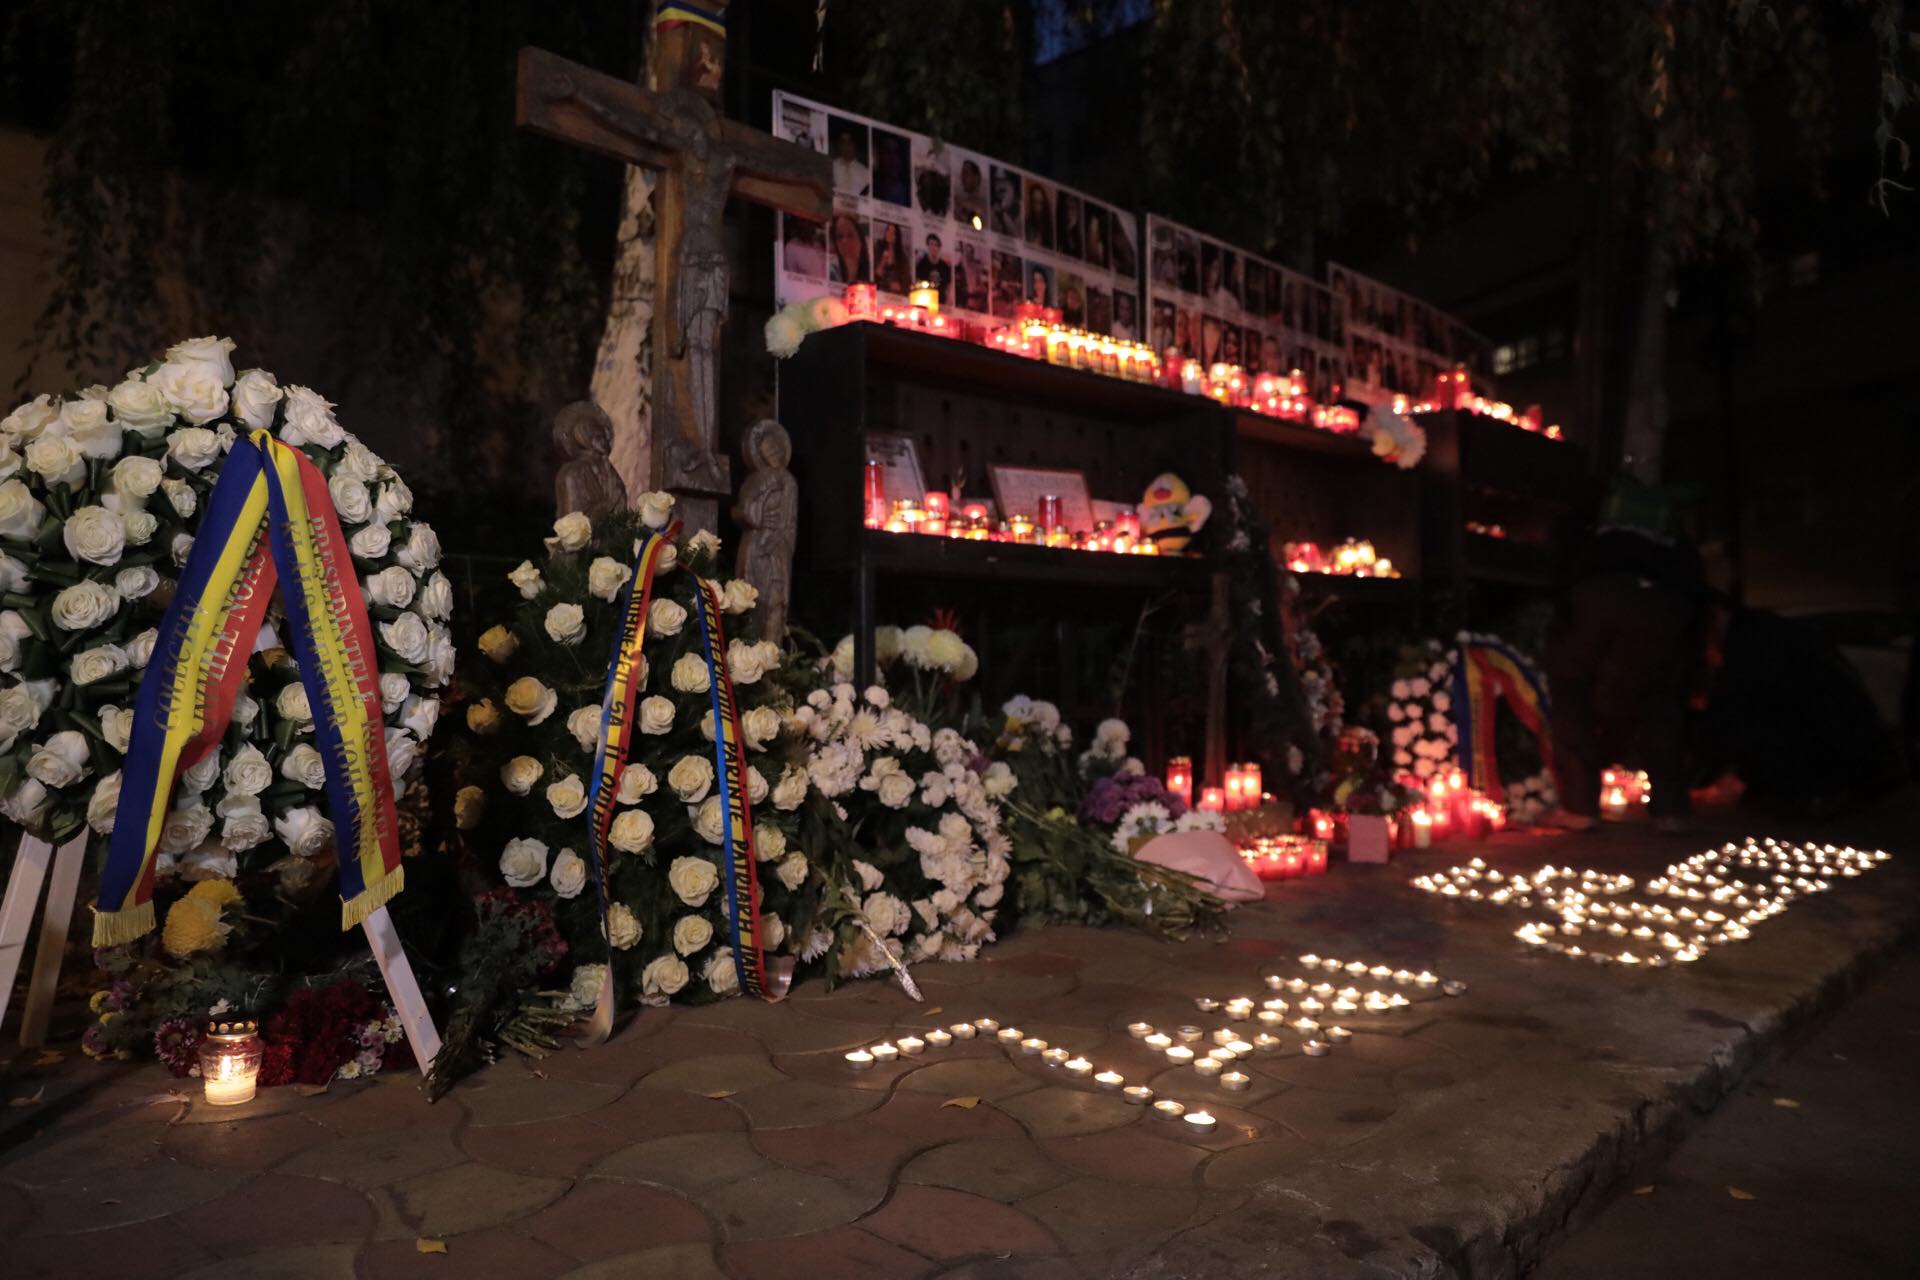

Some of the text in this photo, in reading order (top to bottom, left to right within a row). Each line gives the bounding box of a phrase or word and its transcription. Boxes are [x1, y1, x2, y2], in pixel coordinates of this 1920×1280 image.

[153, 594, 209, 732] COLECTIV
[613, 589, 643, 686] DUMNEZEU
[730, 838, 757, 934] PATRIARH
